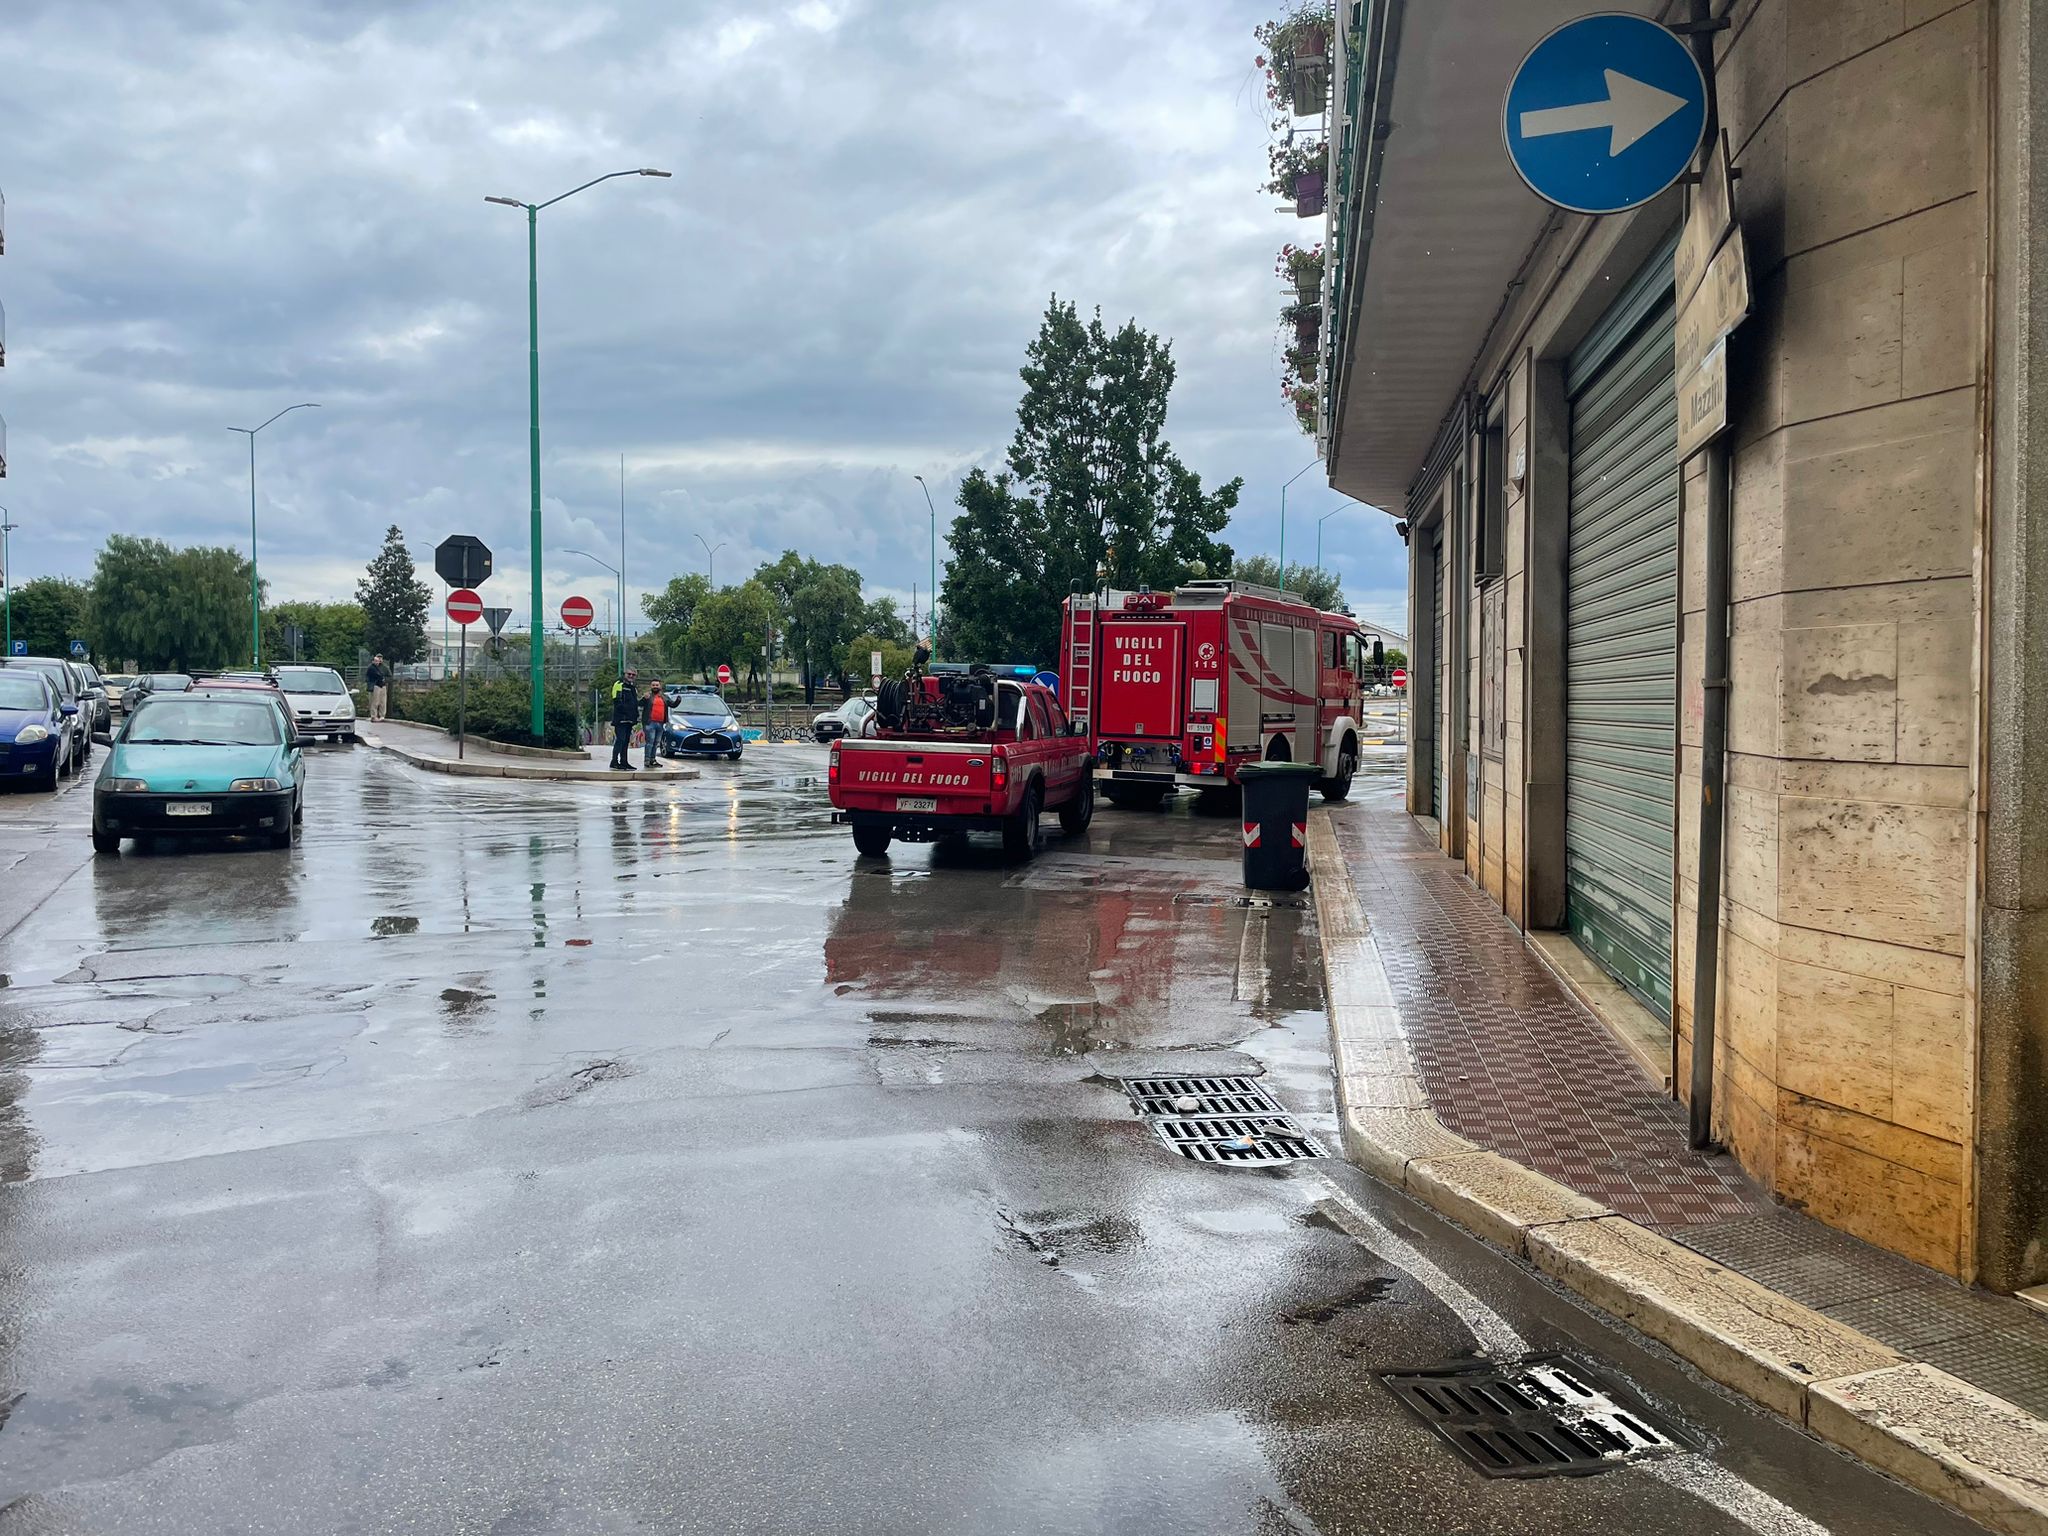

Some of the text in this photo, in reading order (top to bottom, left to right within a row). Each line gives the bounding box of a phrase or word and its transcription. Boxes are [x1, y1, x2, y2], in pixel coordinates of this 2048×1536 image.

[1690, 364, 1723, 429] Mazzini
[1127, 595, 1156, 604] BAI
[14, 642, 24, 653] P
[1115, 637, 1162, 649] VIGILI
[1123, 654, 1152, 666] DEL
[1113, 670, 1161, 683] FUOCO
[858, 770, 970, 786] VIGILI DEL FUOCO
